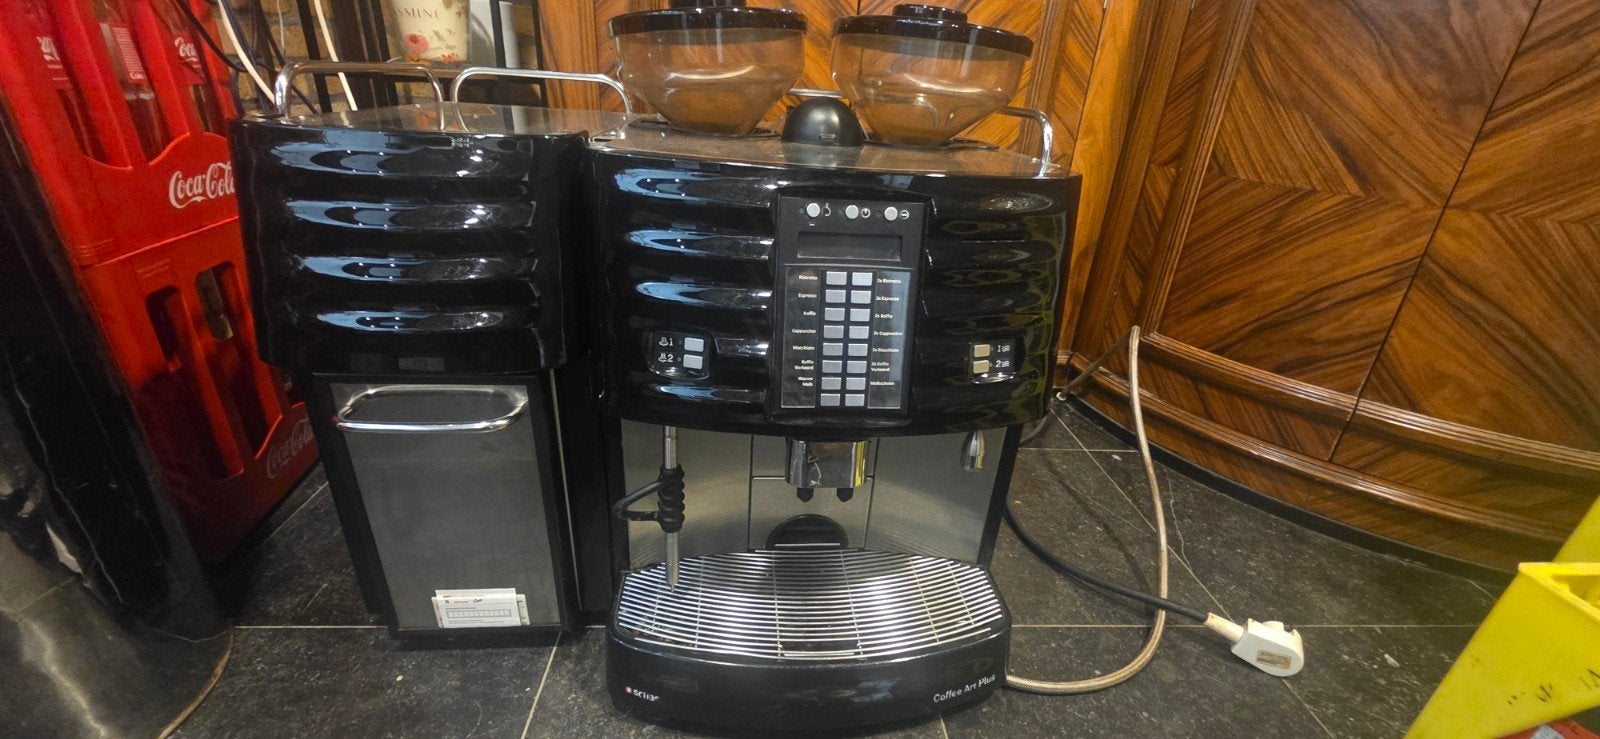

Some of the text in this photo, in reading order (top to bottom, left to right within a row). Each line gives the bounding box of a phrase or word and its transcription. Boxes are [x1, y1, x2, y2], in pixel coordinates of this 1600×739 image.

[669, 338, 674, 346] 1
[667, 354, 674, 362] 2
[933, 674, 996, 703] Coffee Art Plus
